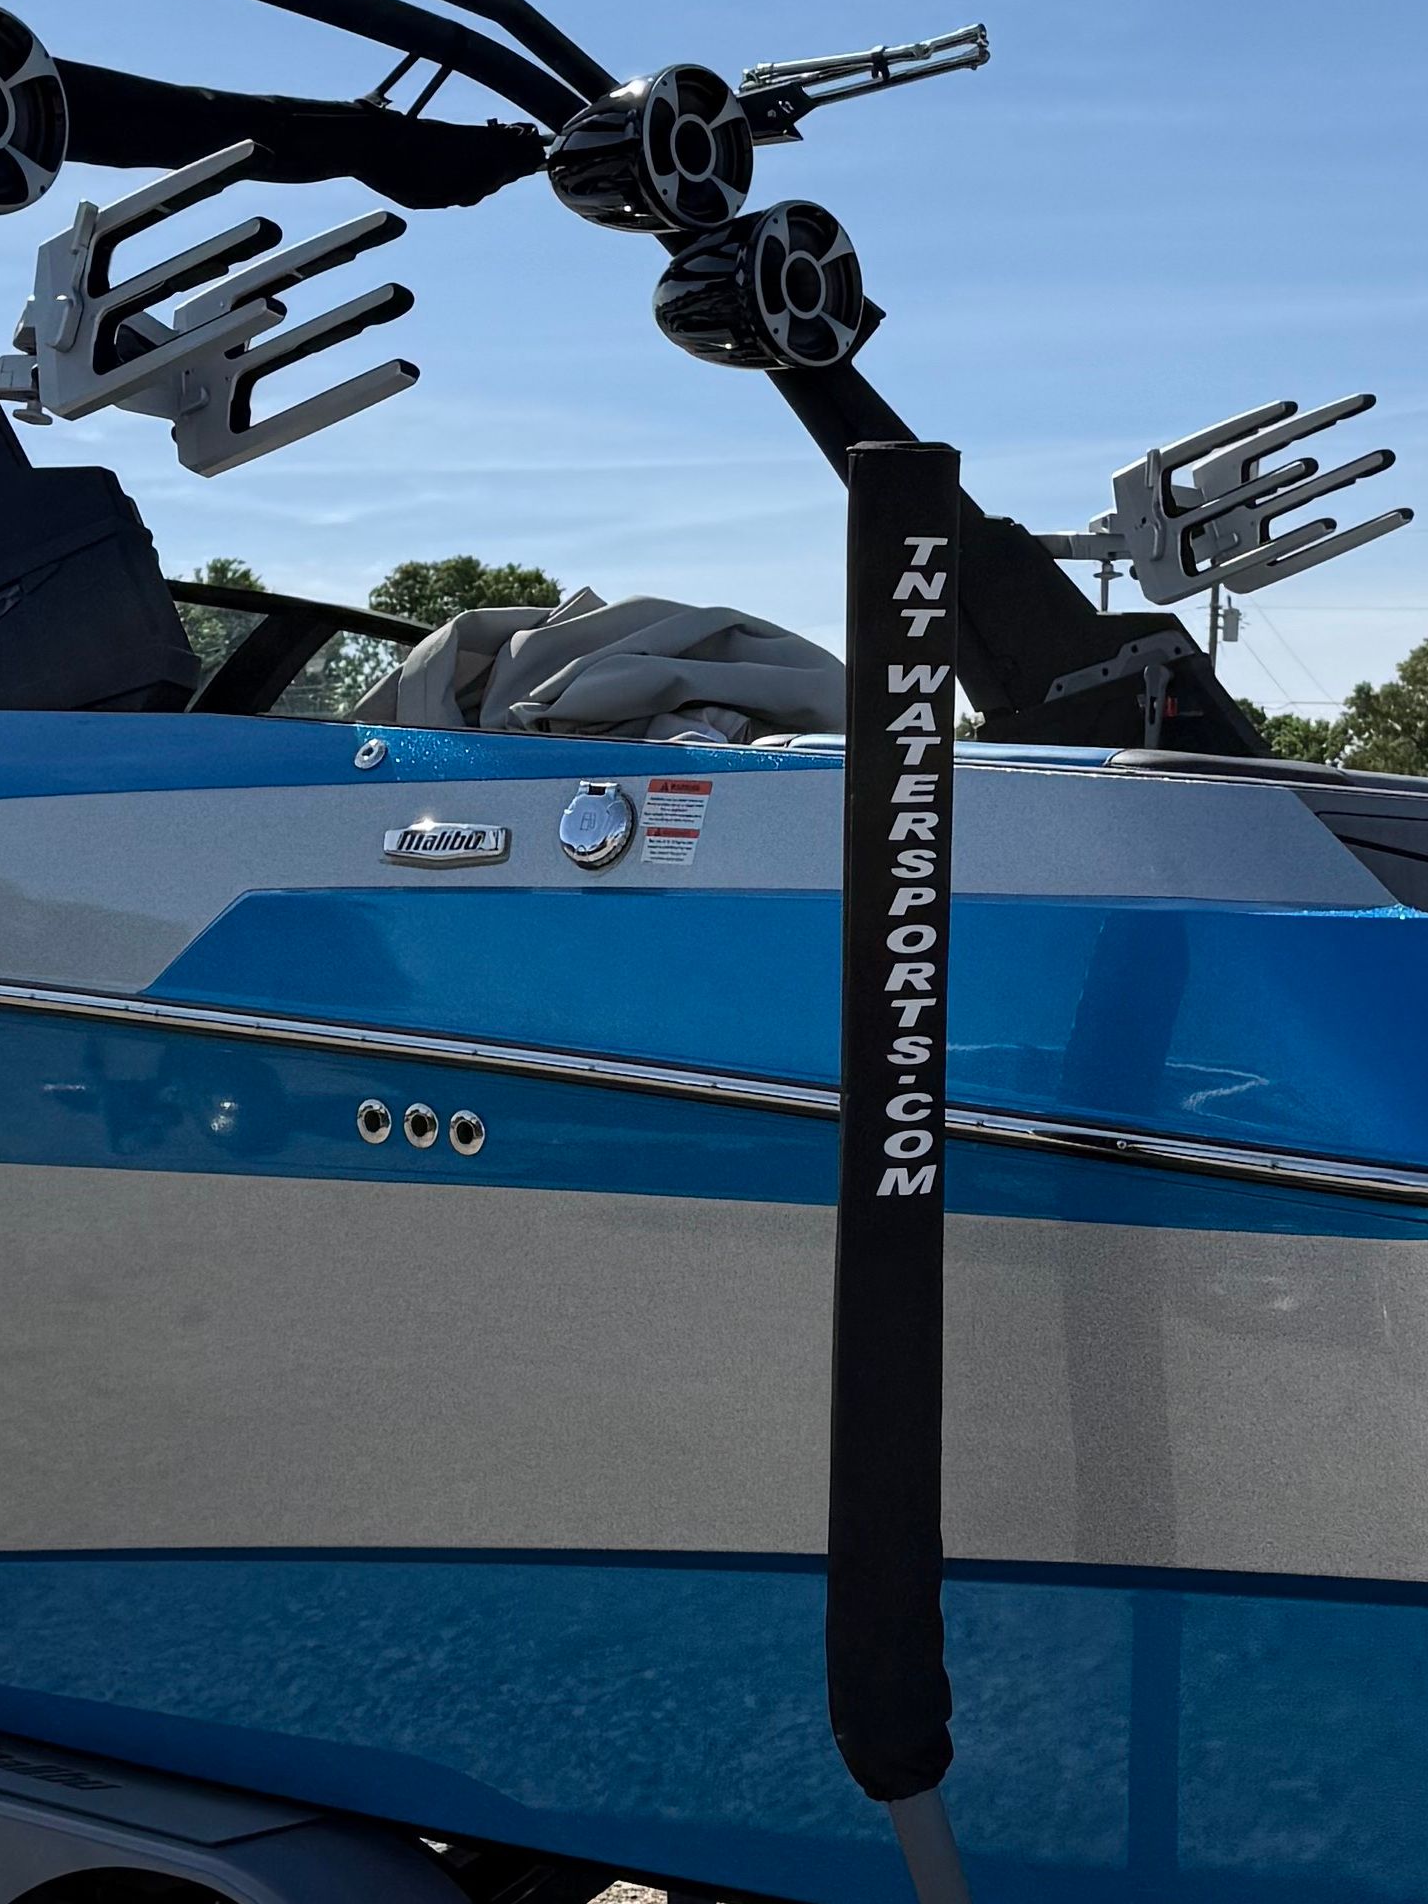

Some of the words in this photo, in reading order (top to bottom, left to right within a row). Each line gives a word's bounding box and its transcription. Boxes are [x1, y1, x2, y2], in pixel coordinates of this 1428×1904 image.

[892, 536, 948, 637] TNT
[396, 830, 486, 851] Malibu
[876, 664, 950, 1197] WATERSPORTS.COM
